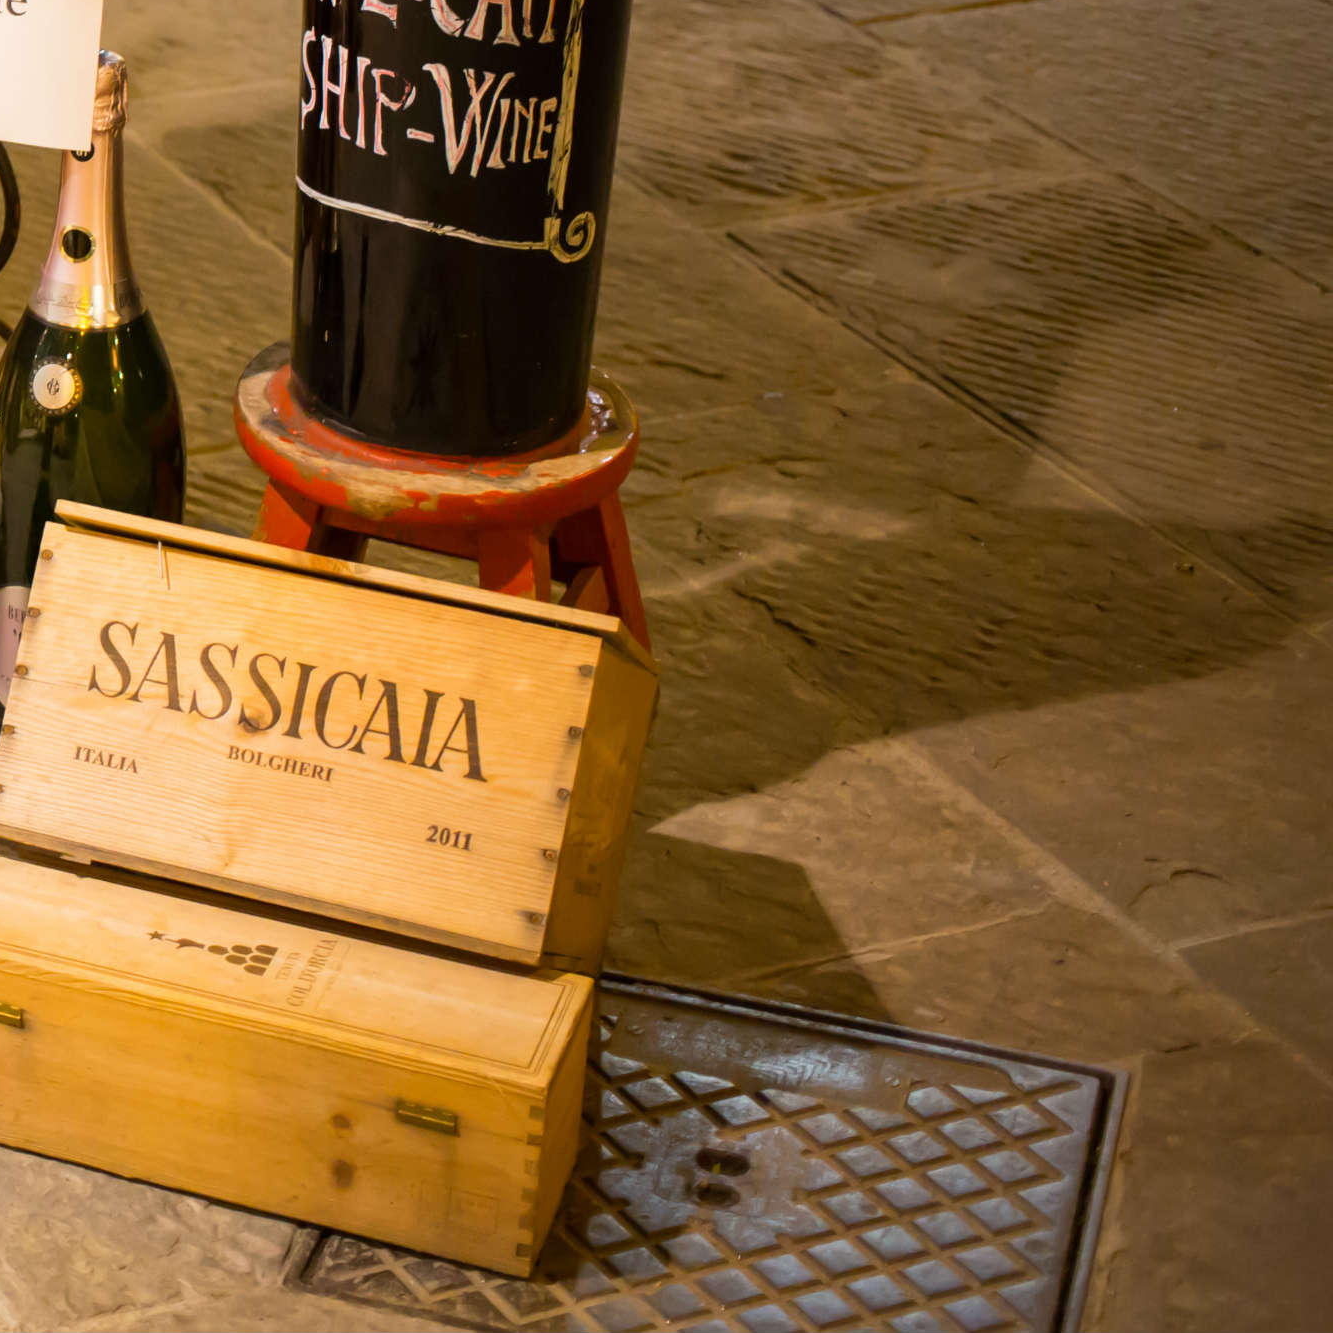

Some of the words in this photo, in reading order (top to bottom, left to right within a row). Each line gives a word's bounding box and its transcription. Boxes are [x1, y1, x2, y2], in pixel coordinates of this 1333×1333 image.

[87, 619, 488, 784] SASSICAIA
[74, 745, 139, 776] ITALIA
[226, 744, 335, 784] BOLGHERI
[425, 823, 474, 853] 2011
